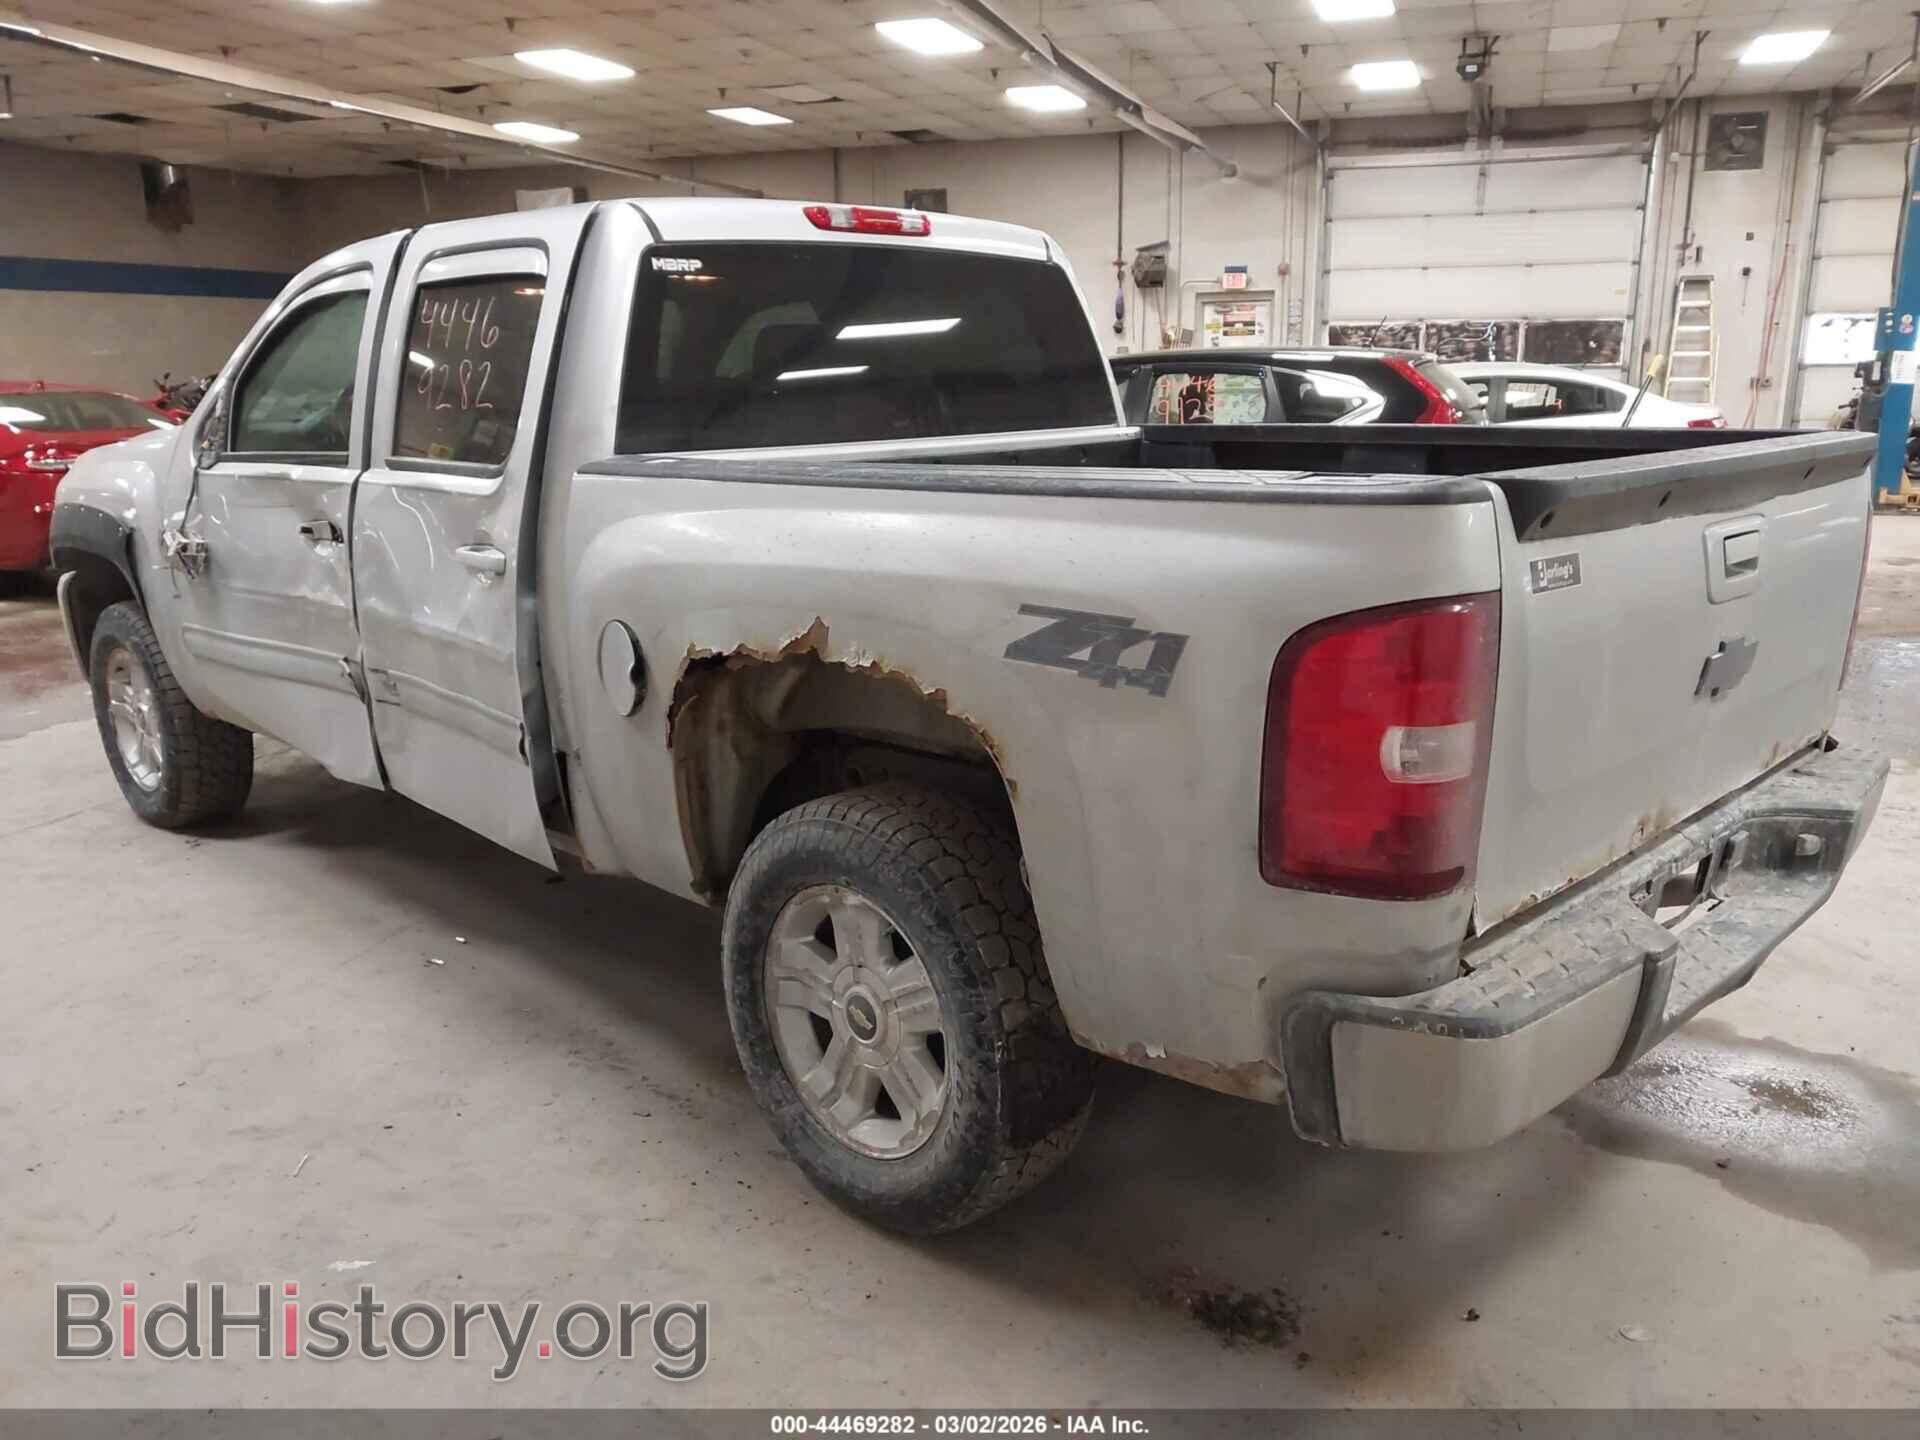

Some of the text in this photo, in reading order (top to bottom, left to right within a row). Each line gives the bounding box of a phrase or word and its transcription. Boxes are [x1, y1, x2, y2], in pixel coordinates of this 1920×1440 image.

[651, 256, 703, 272] MBRP
[420, 296, 500, 350] 4446
[417, 359, 494, 411] 9282
[1003, 603, 1190, 677] Z71
